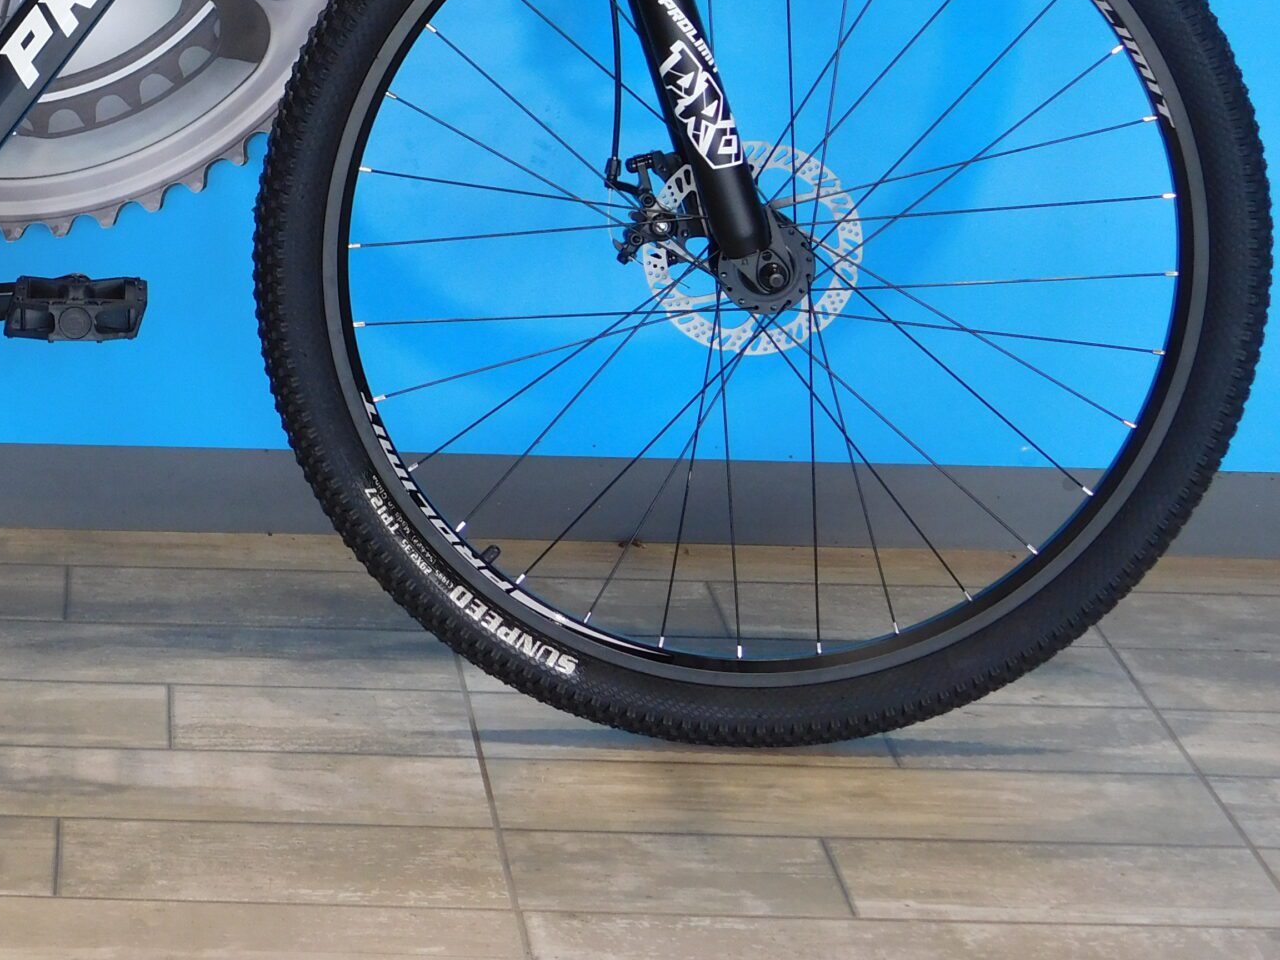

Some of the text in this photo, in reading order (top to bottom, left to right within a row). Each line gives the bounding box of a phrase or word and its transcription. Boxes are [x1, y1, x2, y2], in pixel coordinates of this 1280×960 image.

[360, 391, 518, 595] PROLIMIT
[363, 487, 402, 535] TPI27
[449, 585, 579, 677] SUNPEED
